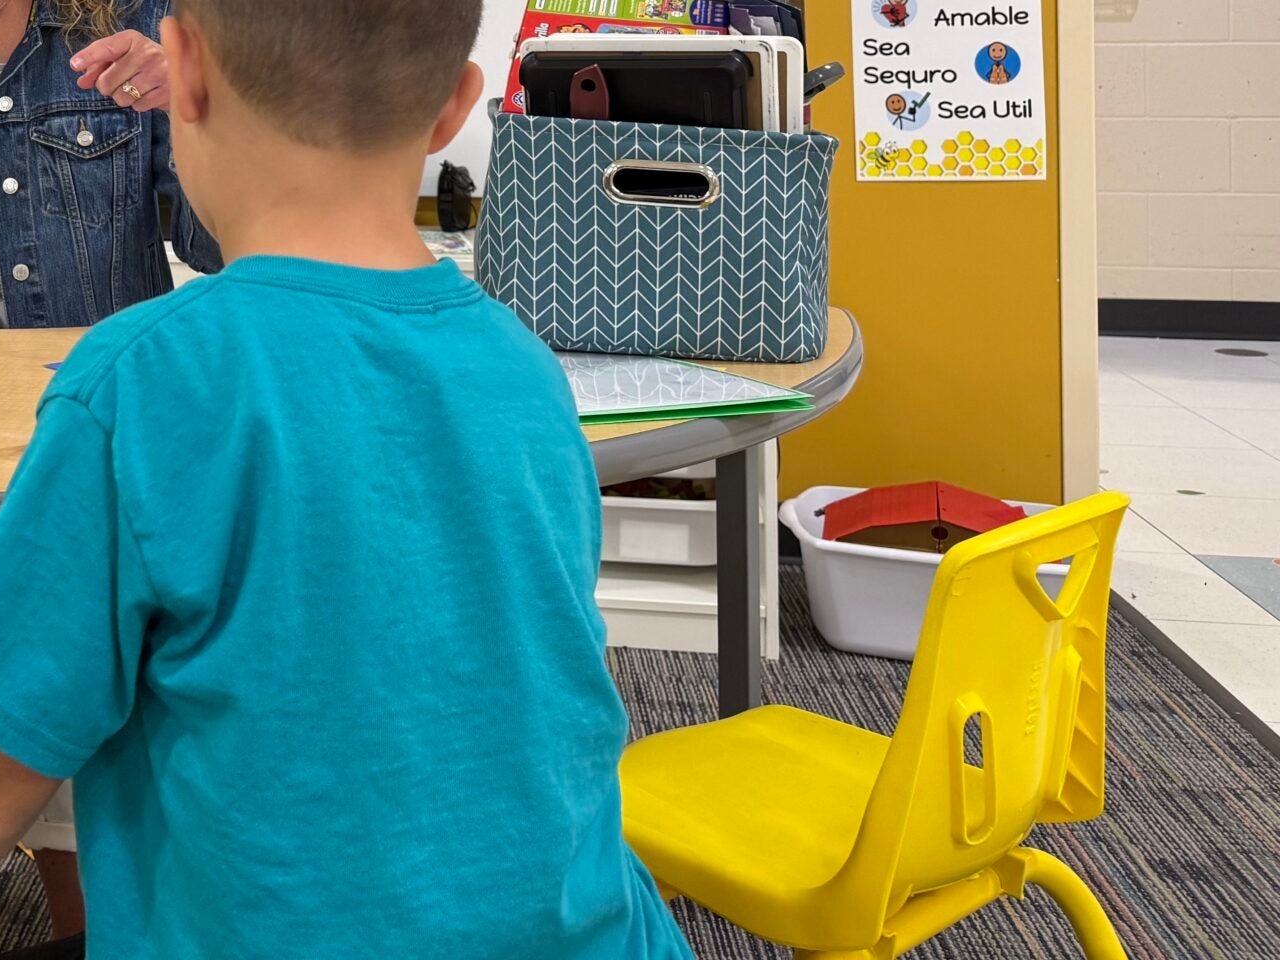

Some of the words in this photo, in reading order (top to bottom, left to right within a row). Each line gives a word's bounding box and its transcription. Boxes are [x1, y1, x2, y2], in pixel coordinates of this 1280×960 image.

[934, 6, 1029, 27] Amable
[863, 38, 910, 56] Sea
[937, 101, 986, 119] Sea
[993, 99, 1032, 119] Util
